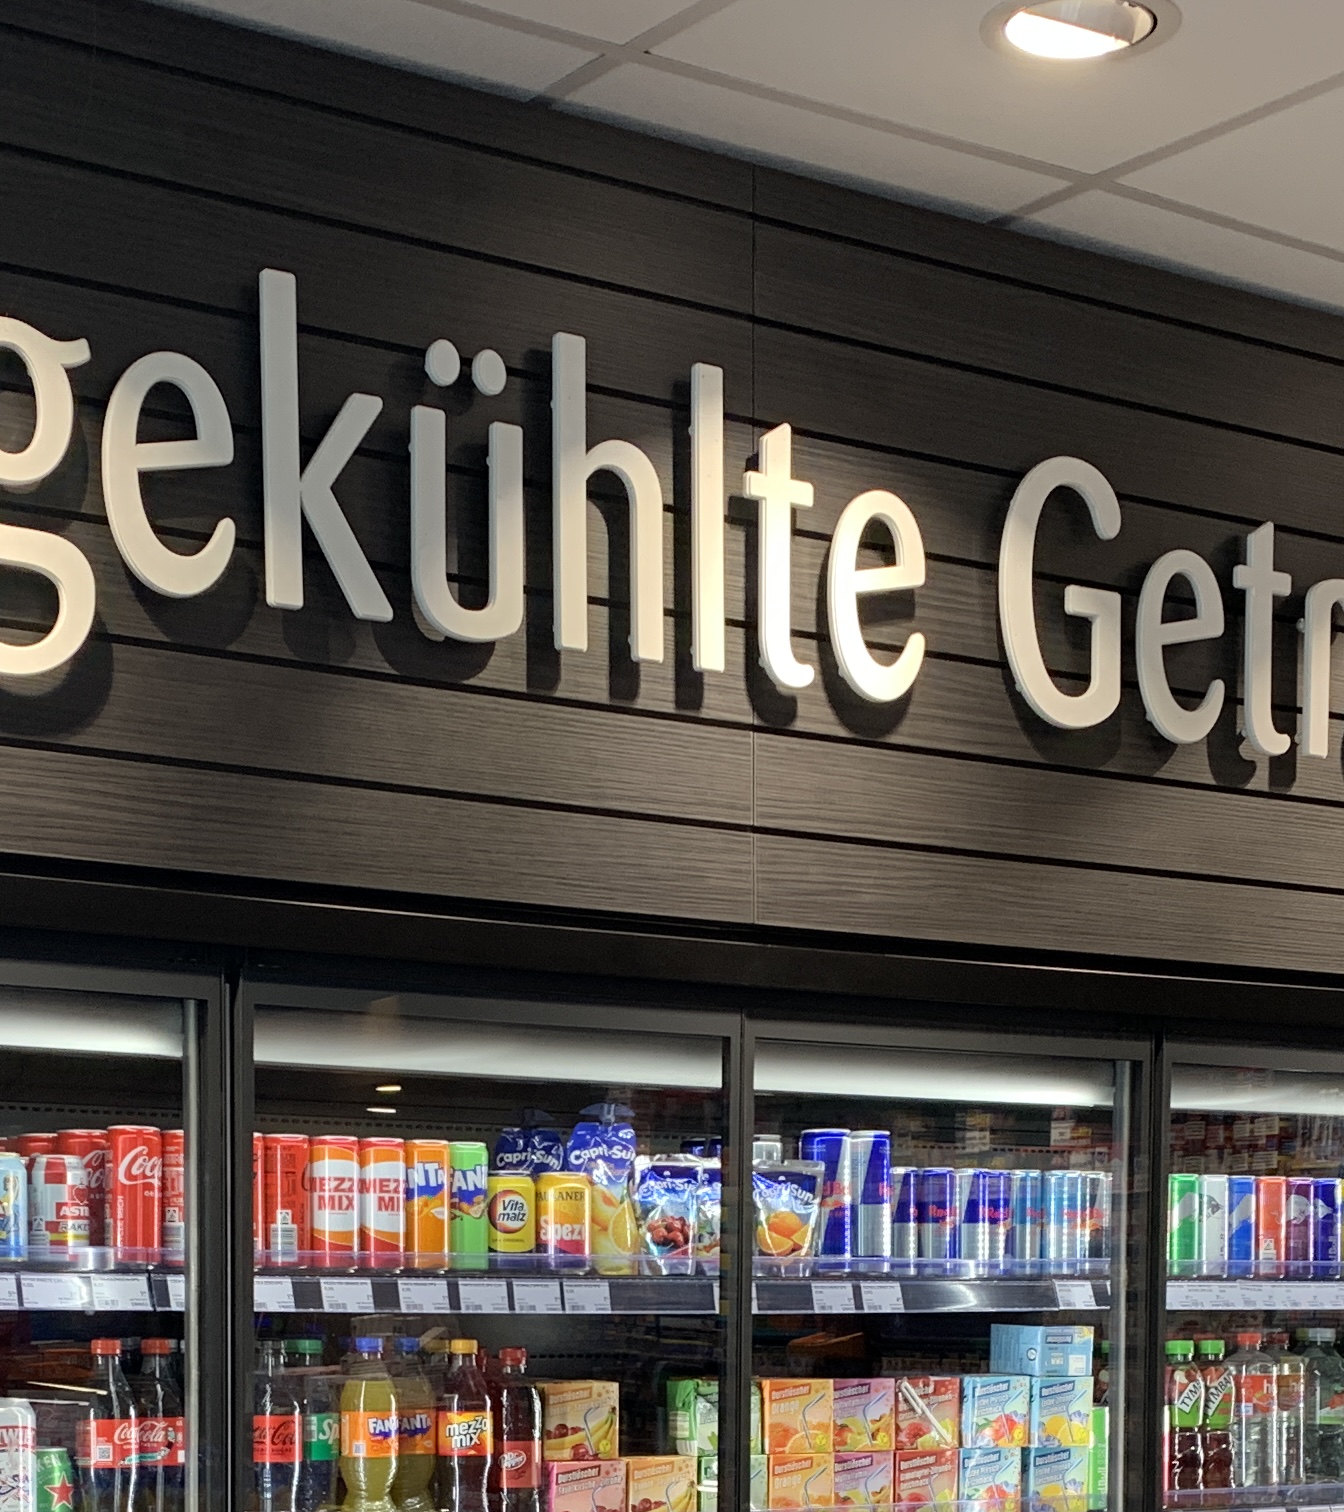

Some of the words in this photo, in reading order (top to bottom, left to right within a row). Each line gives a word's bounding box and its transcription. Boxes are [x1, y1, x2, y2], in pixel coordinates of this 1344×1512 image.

[502, 1200, 526, 1213] Vita
[497, 1210, 527, 1223] malz
[453, 1432, 481, 1447] mix
